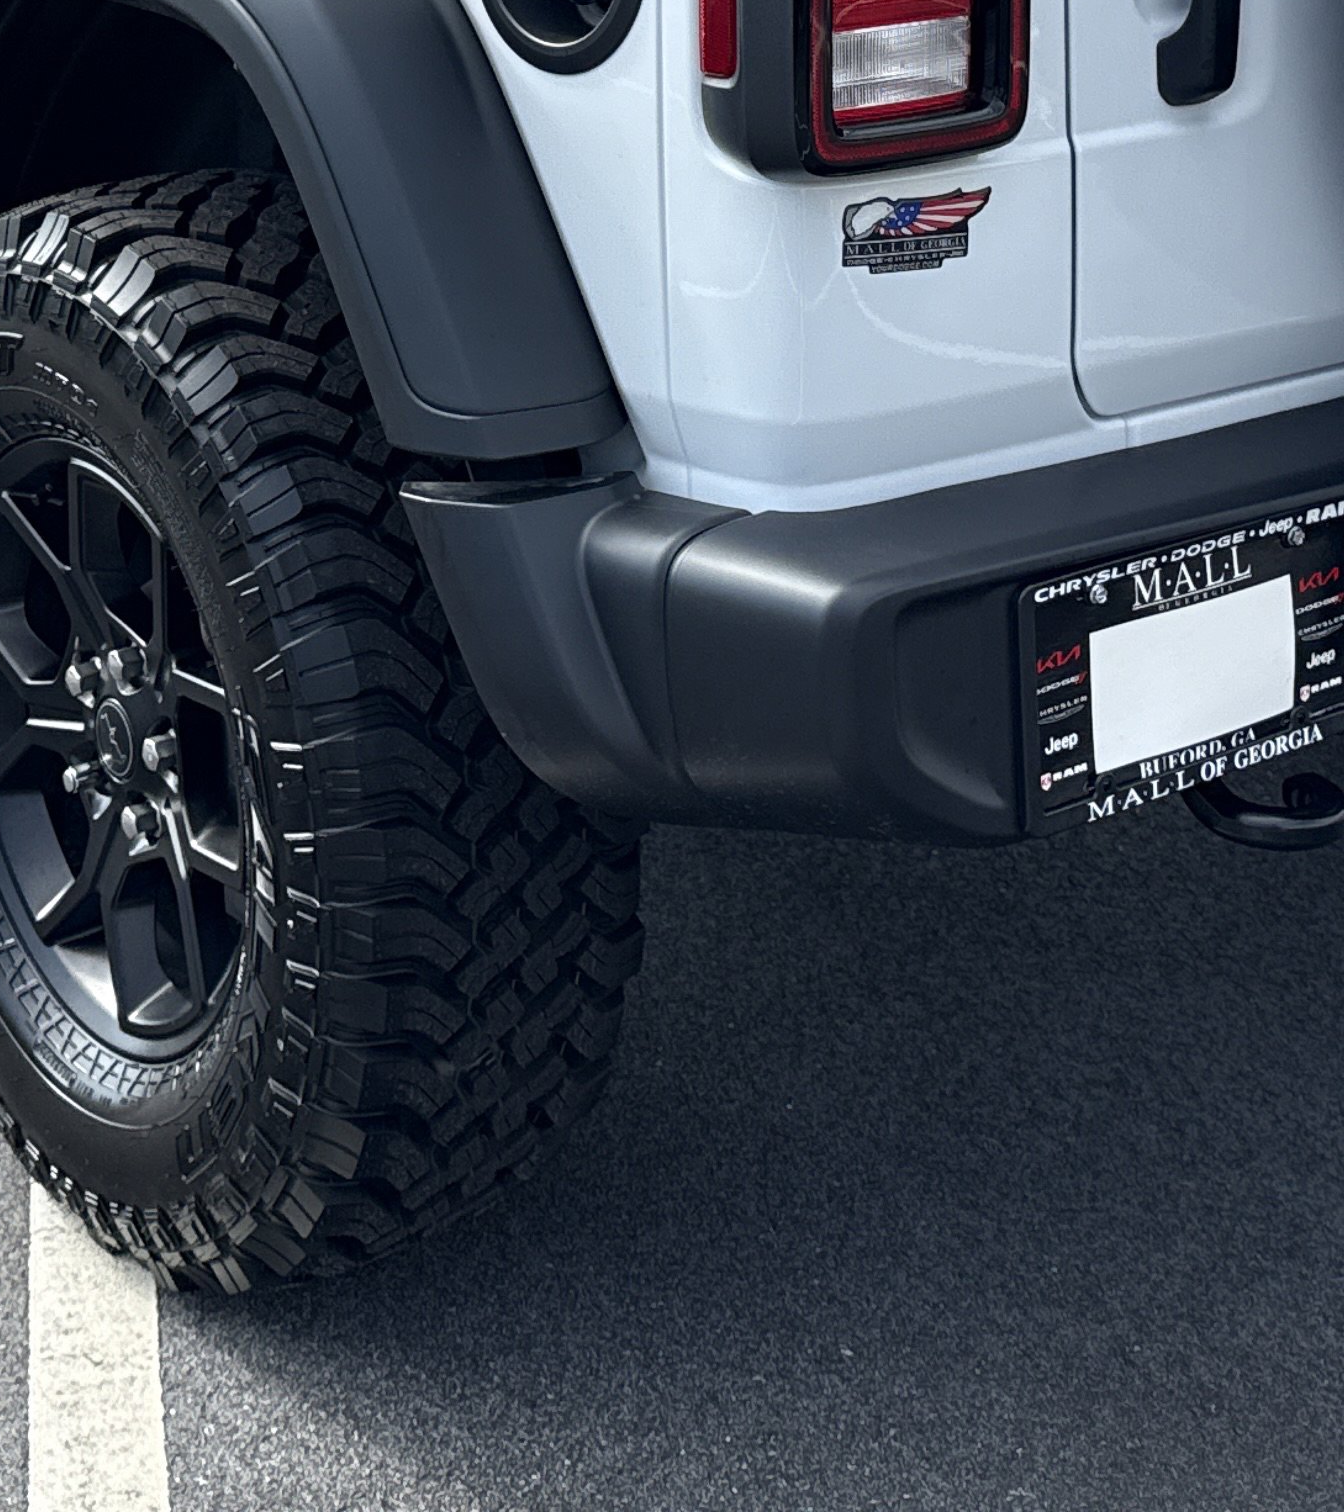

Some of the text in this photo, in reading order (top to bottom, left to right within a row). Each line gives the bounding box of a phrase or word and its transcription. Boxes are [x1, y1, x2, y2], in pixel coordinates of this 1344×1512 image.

[1034, 555, 1157, 603] CHRYSLER
[1171, 530, 1246, 562] DODGE
[1259, 516, 1294, 538] Jeep
[1306, 649, 1336, 669] Jeep
[1311, 676, 1343, 694] RAM
[1044, 732, 1079, 755] Jeep
[1231, 727, 1256, 748] GA
[1200, 759, 1228, 782] OF
[1234, 723, 1324, 769] GEORGIA
[1052, 761, 1088, 782] RAM
